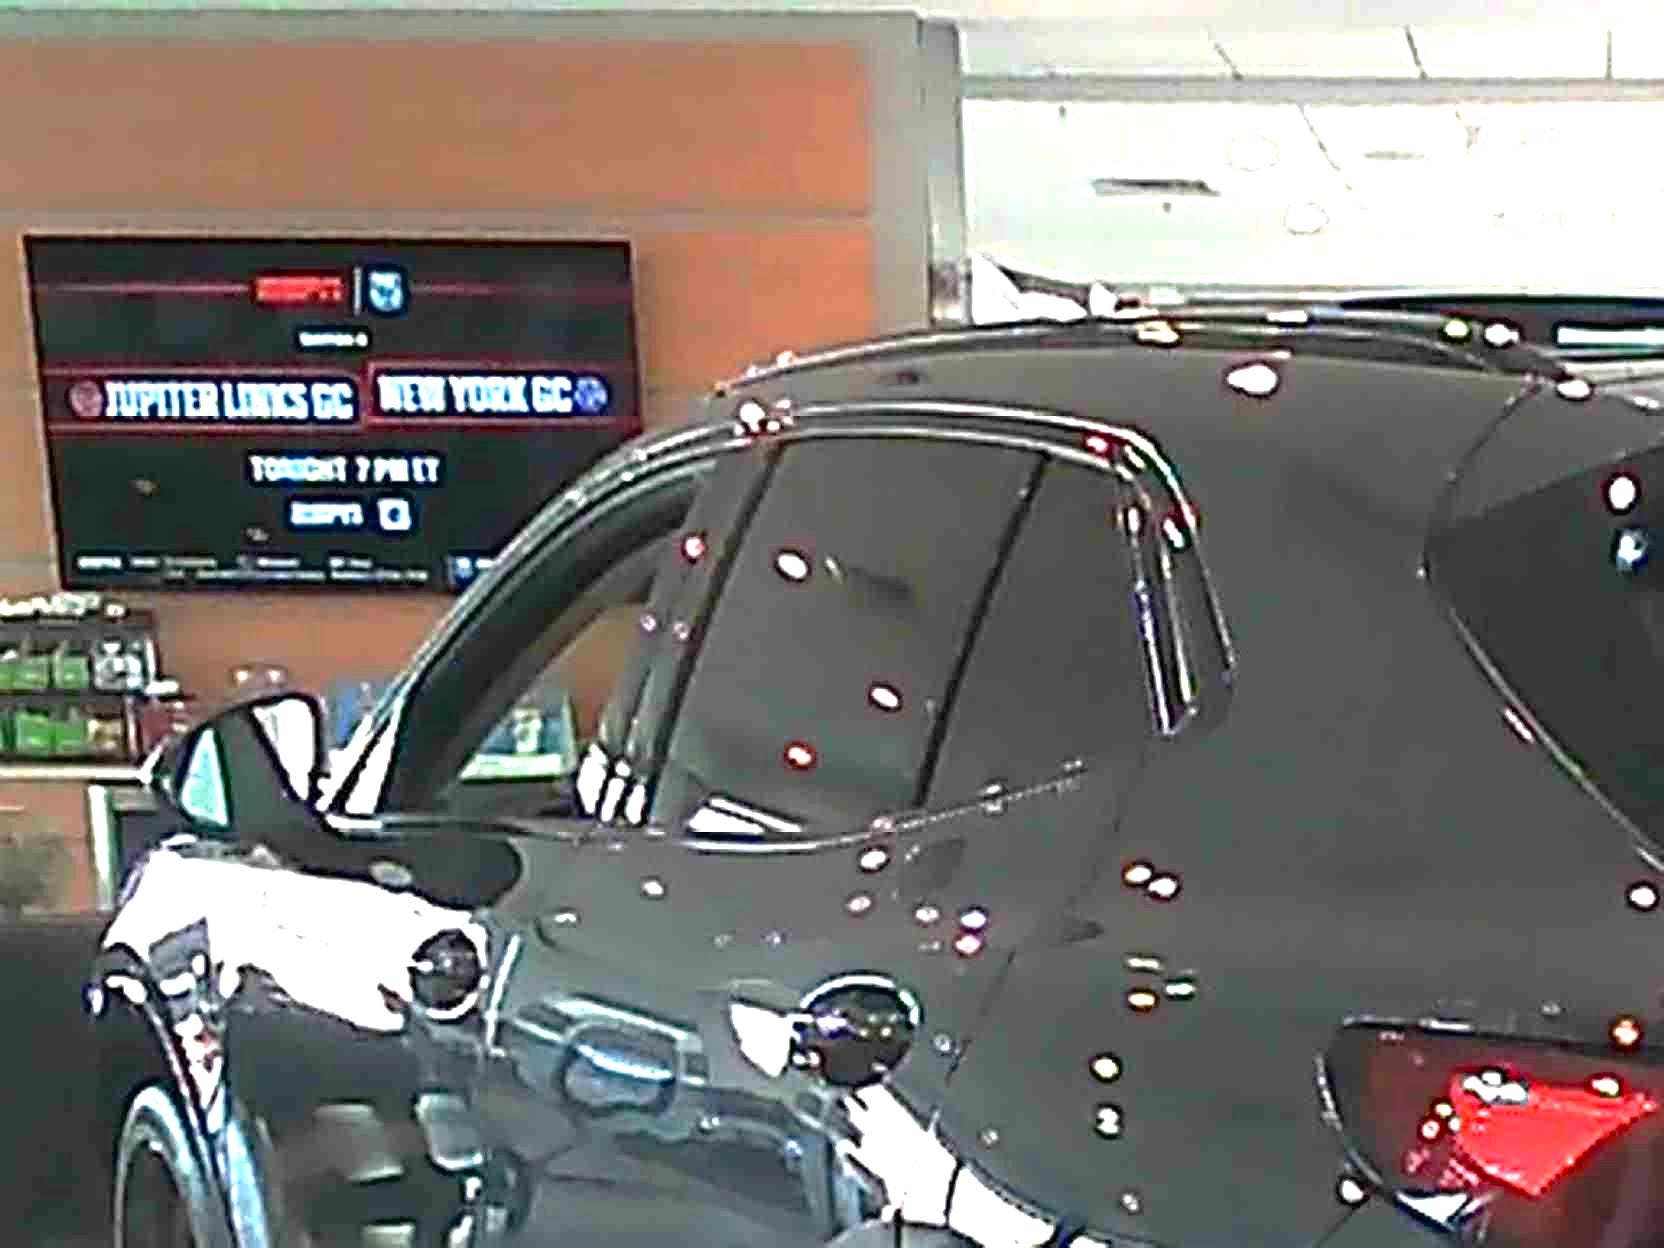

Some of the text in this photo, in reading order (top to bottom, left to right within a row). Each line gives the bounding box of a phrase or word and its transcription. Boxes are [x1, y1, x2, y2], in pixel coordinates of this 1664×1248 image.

[105, 381, 354, 420] JUPITER LINKS GC
[377, 374, 573, 413] NEW YORK GC
